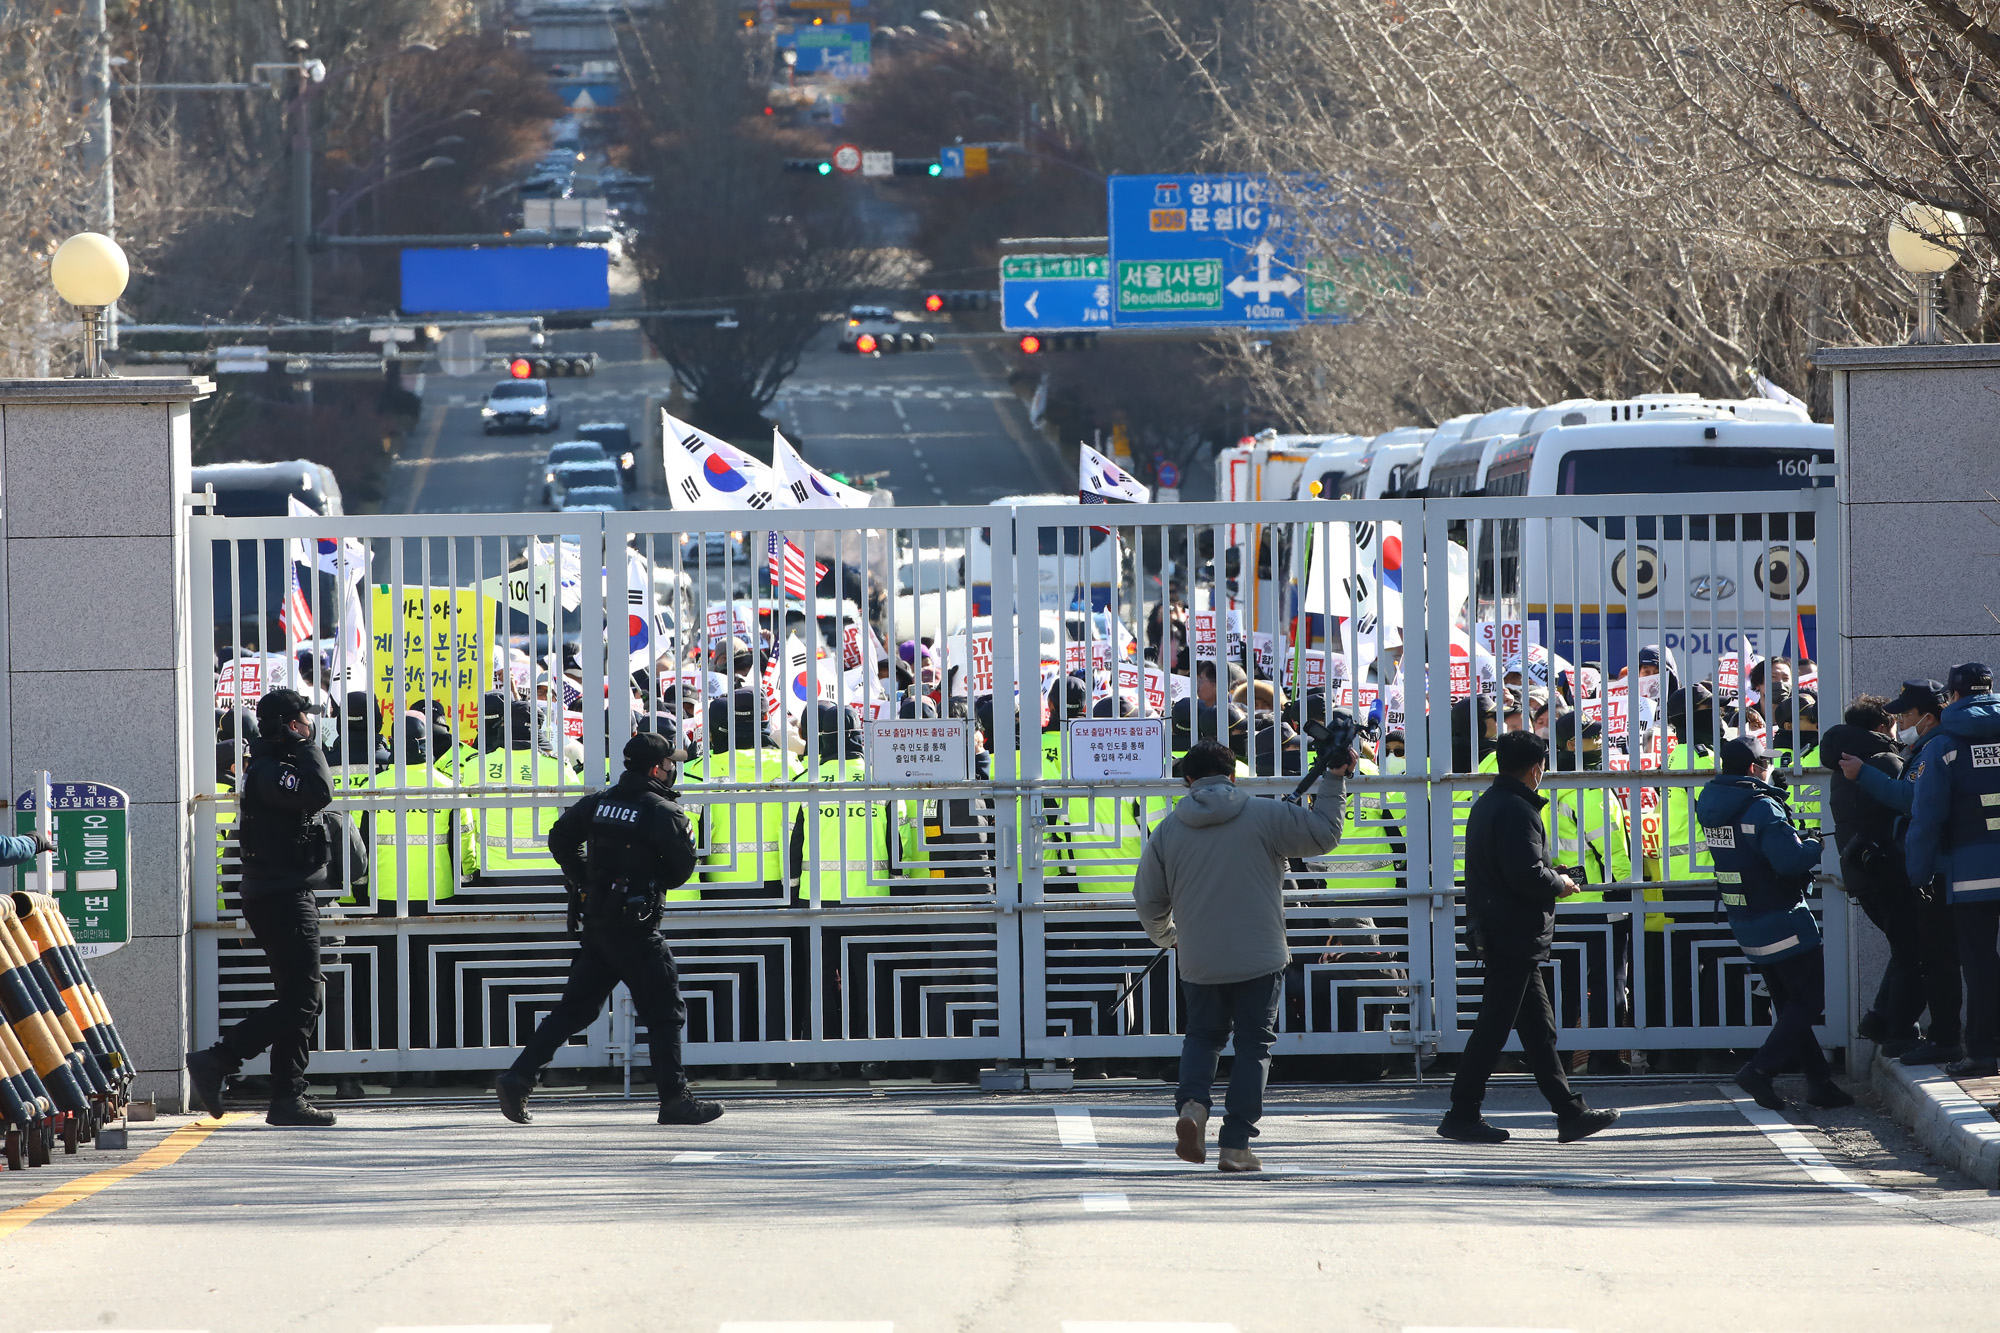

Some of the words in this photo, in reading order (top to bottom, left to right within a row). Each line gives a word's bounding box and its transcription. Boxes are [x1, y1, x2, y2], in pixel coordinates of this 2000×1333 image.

[1164, 190, 1171, 203] 1
[1188, 181, 1260, 205] 양재IC
[1153, 212, 1184, 229] 309
[1122, 264, 1218, 288] 서울(사당)
[1244, 304, 1285, 319] 100m
[1484, 624, 1522, 638] SOP
[1665, 633, 1758, 655] POLICE
[973, 655, 992, 673] TH
[1289, 659, 1321, 672] 윤열
[221, 665, 256, 680] 윤열
[563, 720, 583, 735] 윤석
[877, 728, 891, 737] 도보
[893, 727, 914, 737] 출입자
[915, 727, 929, 736] 차도
[931, 727, 945, 737] 출입
[947, 727, 960, 736] 금지
[1075, 728, 1089, 736] 도보
[1091, 727, 1112, 737] 출입자
[1114, 727, 1127, 736] 차도
[1129, 727, 1143, 736] 출입
[1145, 726, 1159, 736] 금지
[892, 743, 906, 752] 우측
[908, 743, 929, 752] 인도를
[932, 742, 947, 751] 통해
[1090, 742, 1104, 751] 우측
[1106, 742, 1128, 750] 인도를
[1130, 741, 1145, 750] 통해
[896, 754, 917, 764] 출입해
[919, 754, 944, 763] 주세요.
[1094, 753, 1115, 762] 출입해
[1117, 753, 1142, 762] 주세요.
[23, 796, 119, 809] 승차요일제적용
[595, 804, 638, 823] POLICE
[819, 807, 878, 818] OLICE
[82, 815, 109, 866] 오늘은
[1708, 839, 1733, 847] POLICE
[84, 896, 109, 911] 번
[77, 946, 98, 955] 청사
